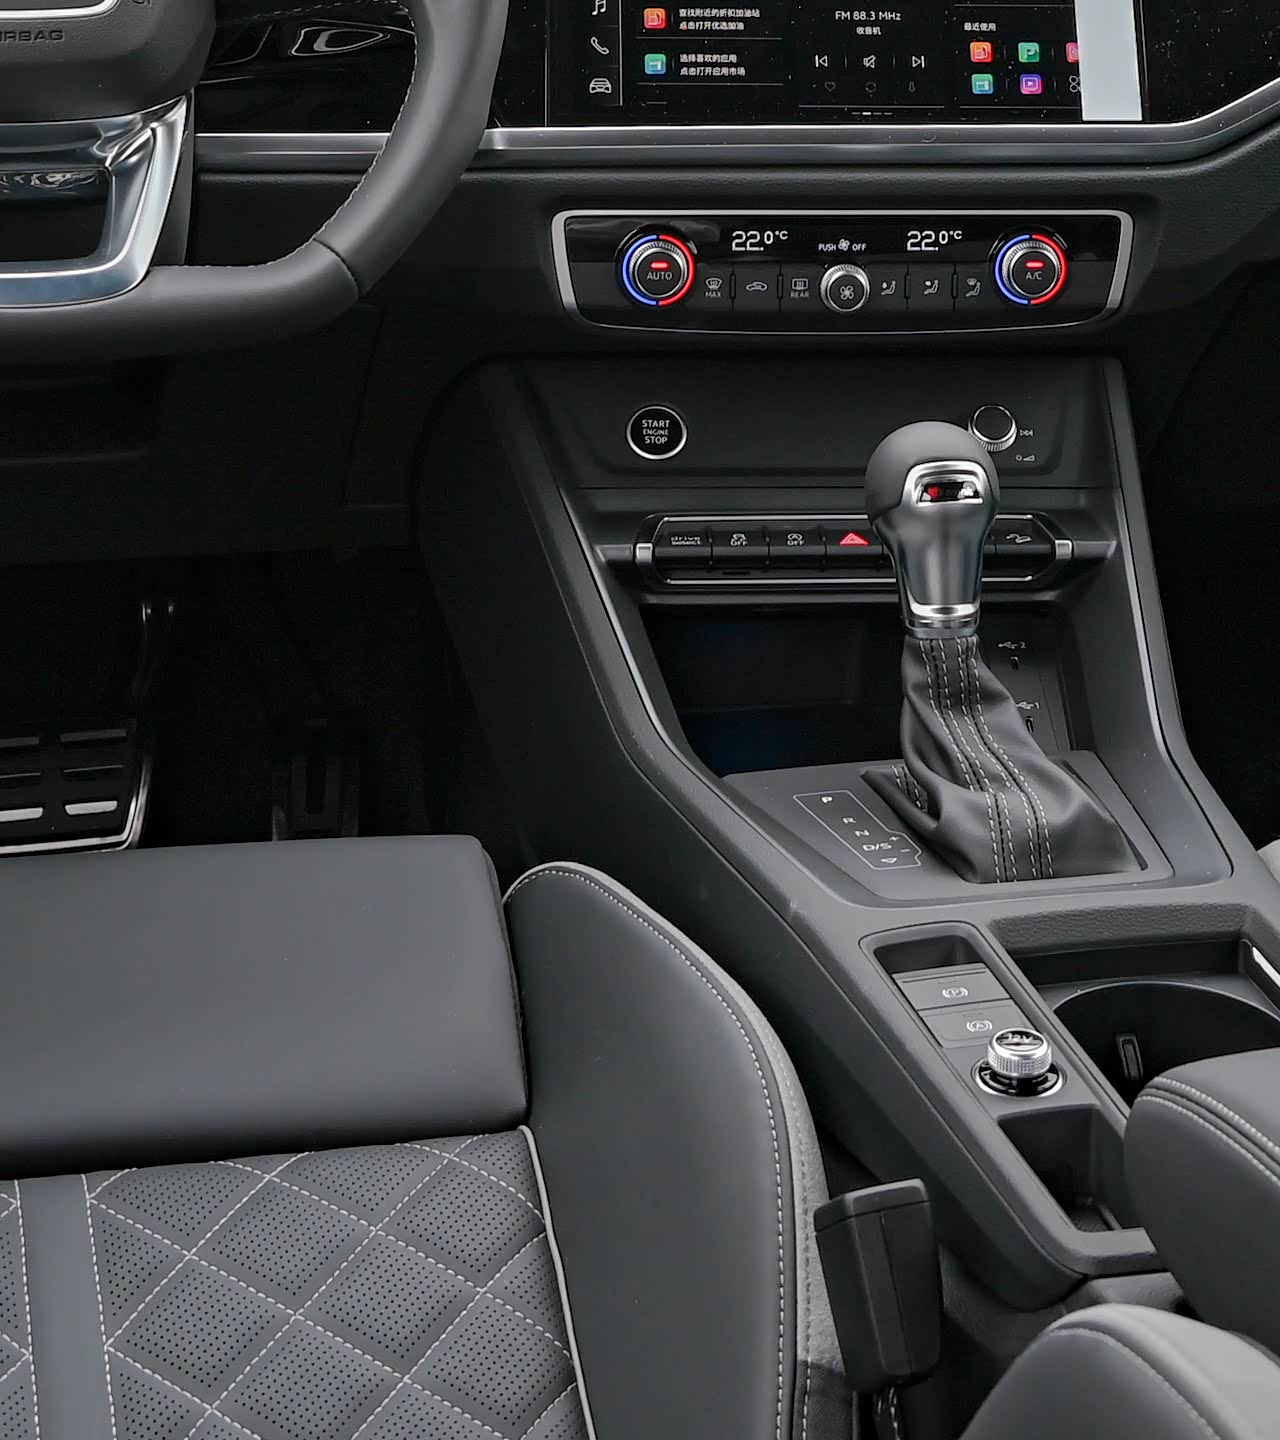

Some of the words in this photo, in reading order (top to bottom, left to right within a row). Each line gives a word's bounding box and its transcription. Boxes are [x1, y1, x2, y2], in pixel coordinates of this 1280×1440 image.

[835, 12, 851, 21] FM
[853, 12, 876, 21] 88.3
[878, 11, 902, 21] MHz
[856, 26, 881, 36] 收音机
[964, 22, 997, 31] 最近使用
[818, 243, 837, 252] PUSH
[852, 242, 867, 252] OFF
[646, 271, 672, 281] AUTO
[1025, 271, 1042, 281] A/C
[790, 291, 809, 299] REAR
[642, 420, 670, 428] START
[644, 436, 668, 444] STOP
